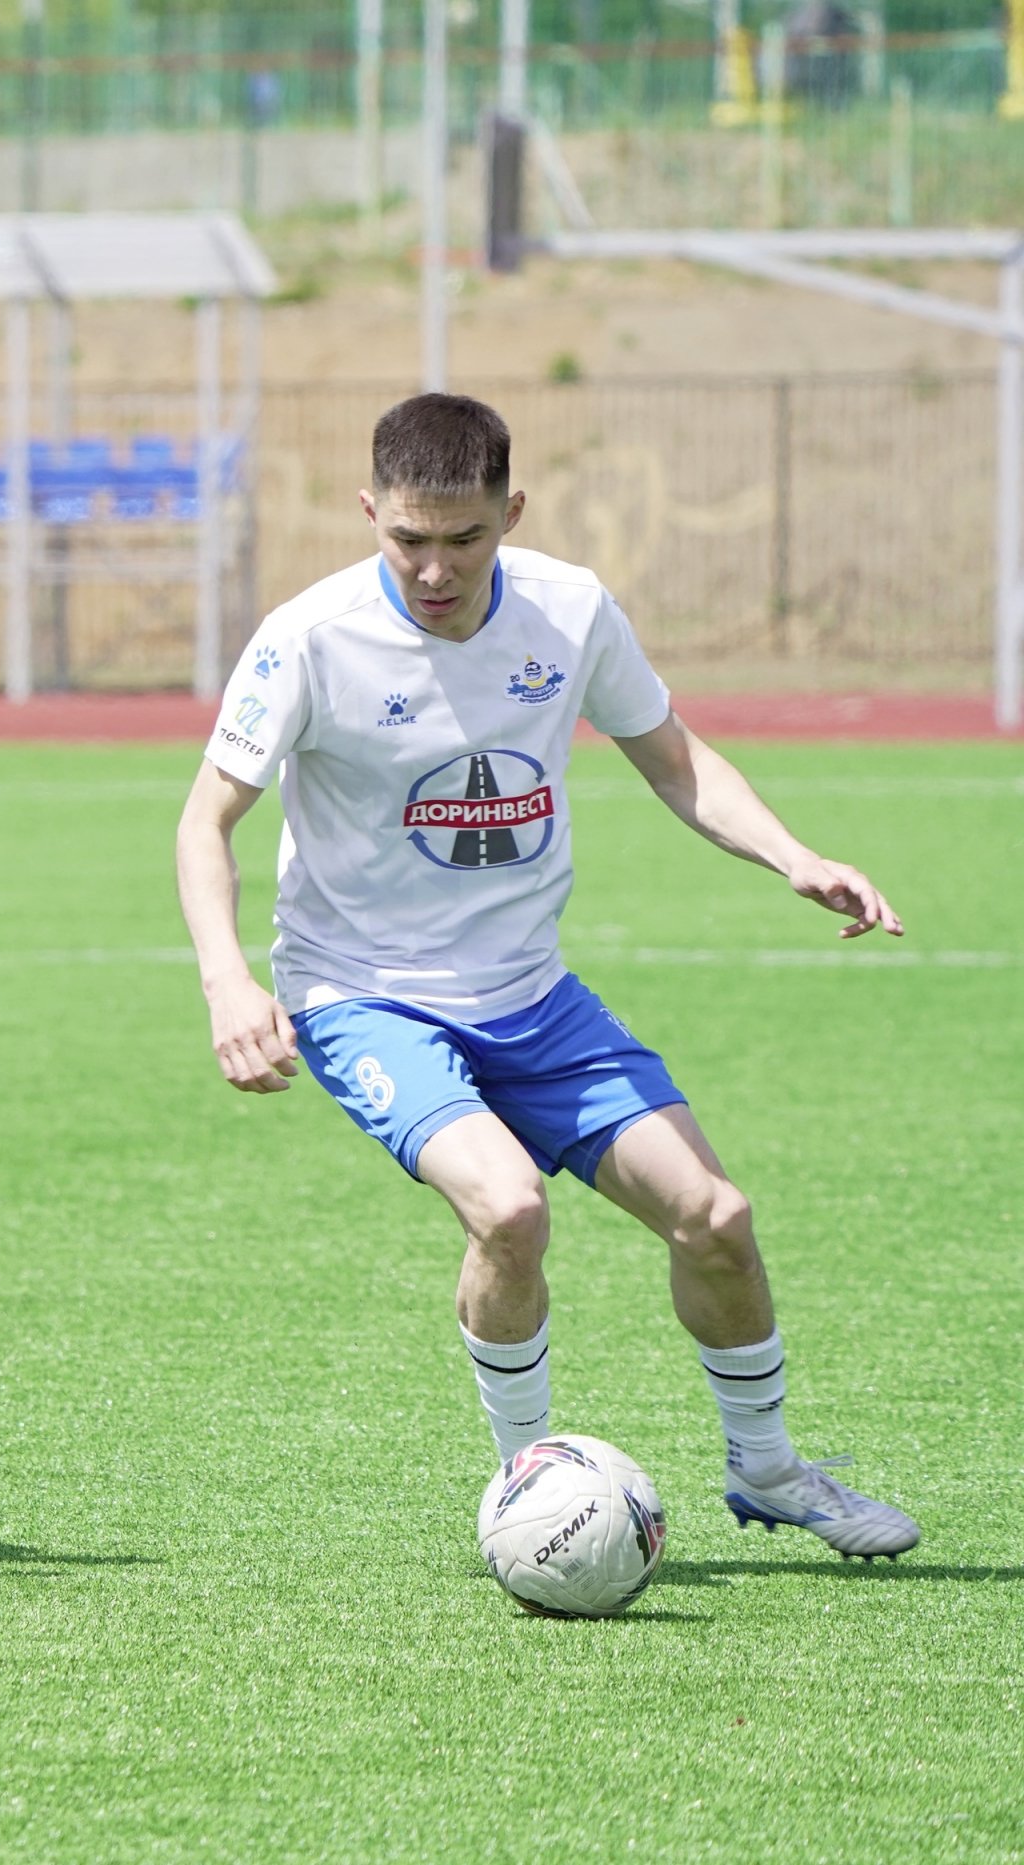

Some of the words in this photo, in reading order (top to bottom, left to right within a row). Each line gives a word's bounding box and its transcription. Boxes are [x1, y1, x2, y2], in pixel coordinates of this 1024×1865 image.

[377, 715, 417, 727] KELME
[409, 792, 547, 823] ДОРИНВЕСТ
[356, 1056, 395, 1111] 8
[534, 1499, 599, 1566] DEMIX
